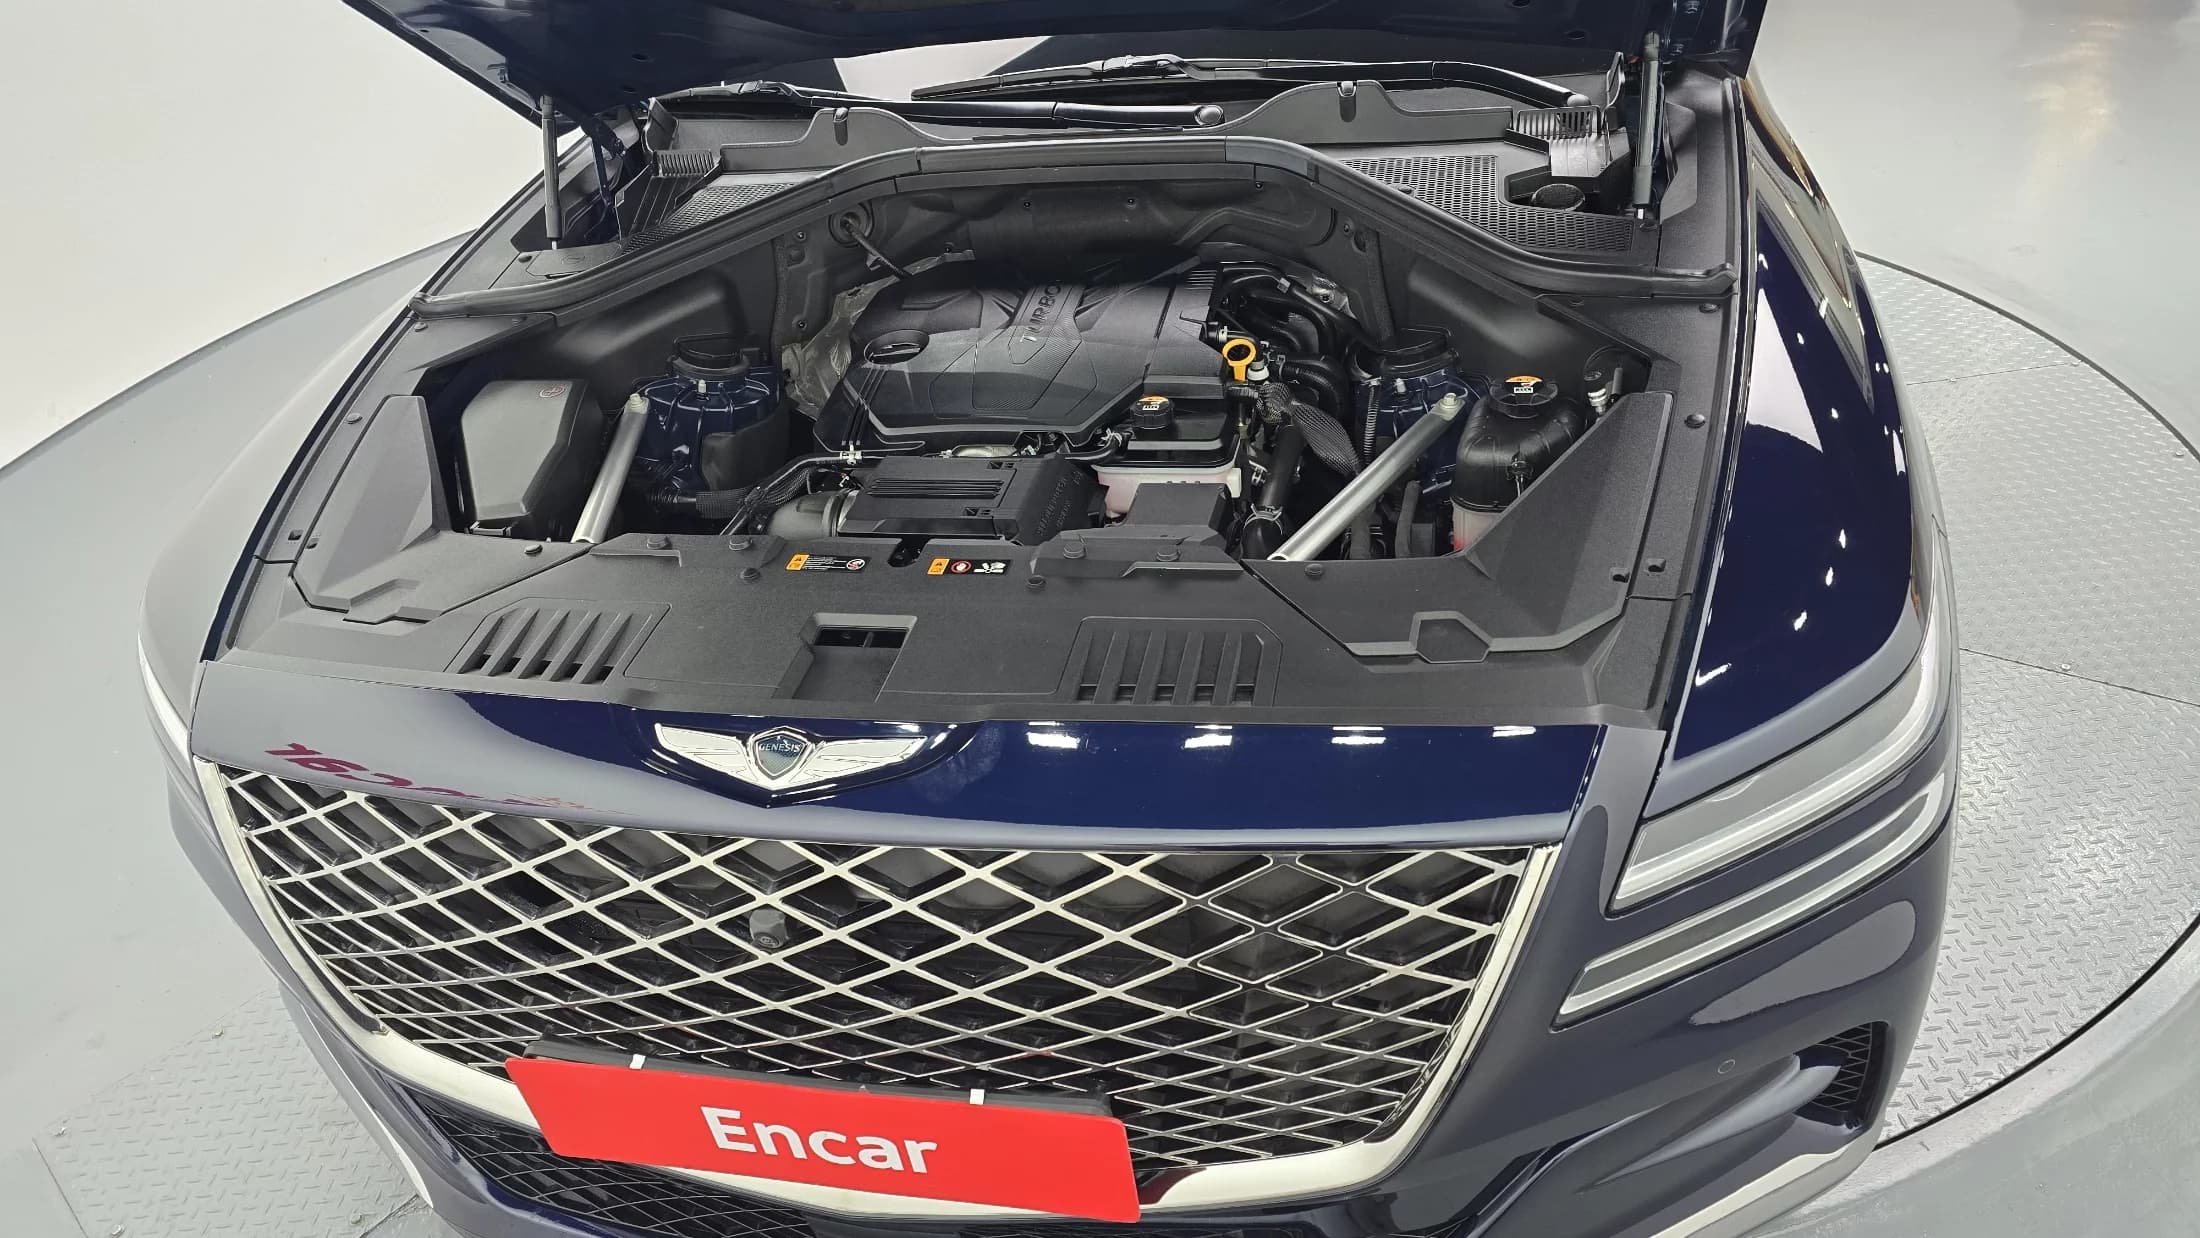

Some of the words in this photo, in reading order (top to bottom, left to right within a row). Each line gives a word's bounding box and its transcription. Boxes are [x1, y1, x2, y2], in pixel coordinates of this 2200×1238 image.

[1020, 282, 1062, 342] TURBO
[759, 742, 802, 753] GENESIS
[700, 1105, 937, 1174] Encar
